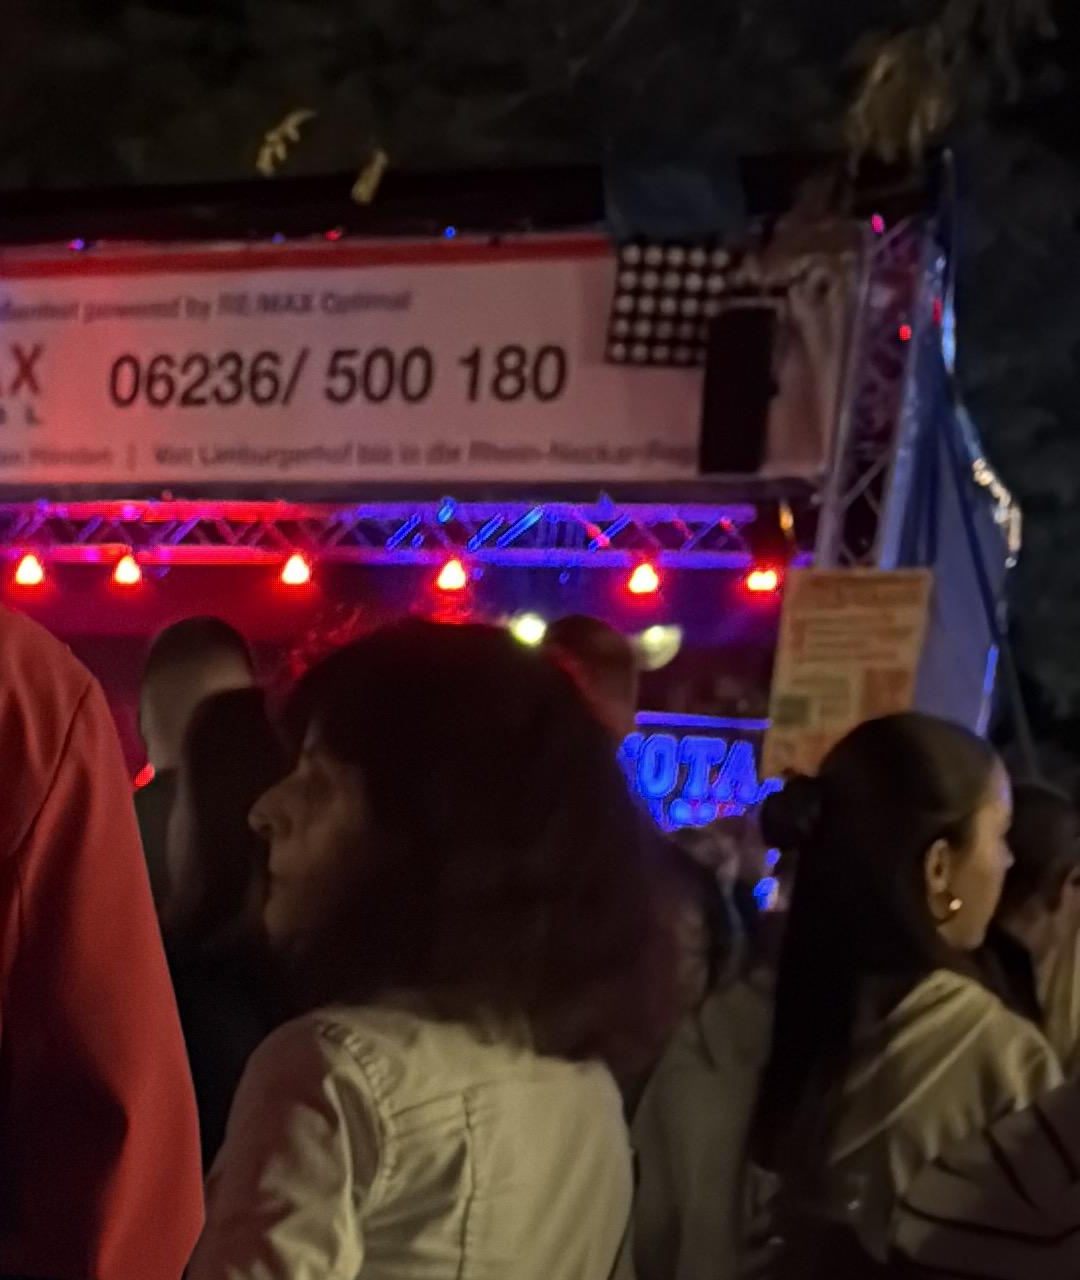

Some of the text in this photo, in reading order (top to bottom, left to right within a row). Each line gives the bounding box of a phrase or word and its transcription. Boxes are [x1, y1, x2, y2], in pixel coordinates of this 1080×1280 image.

[110, 345, 566, 407] 06236/ 500 180
